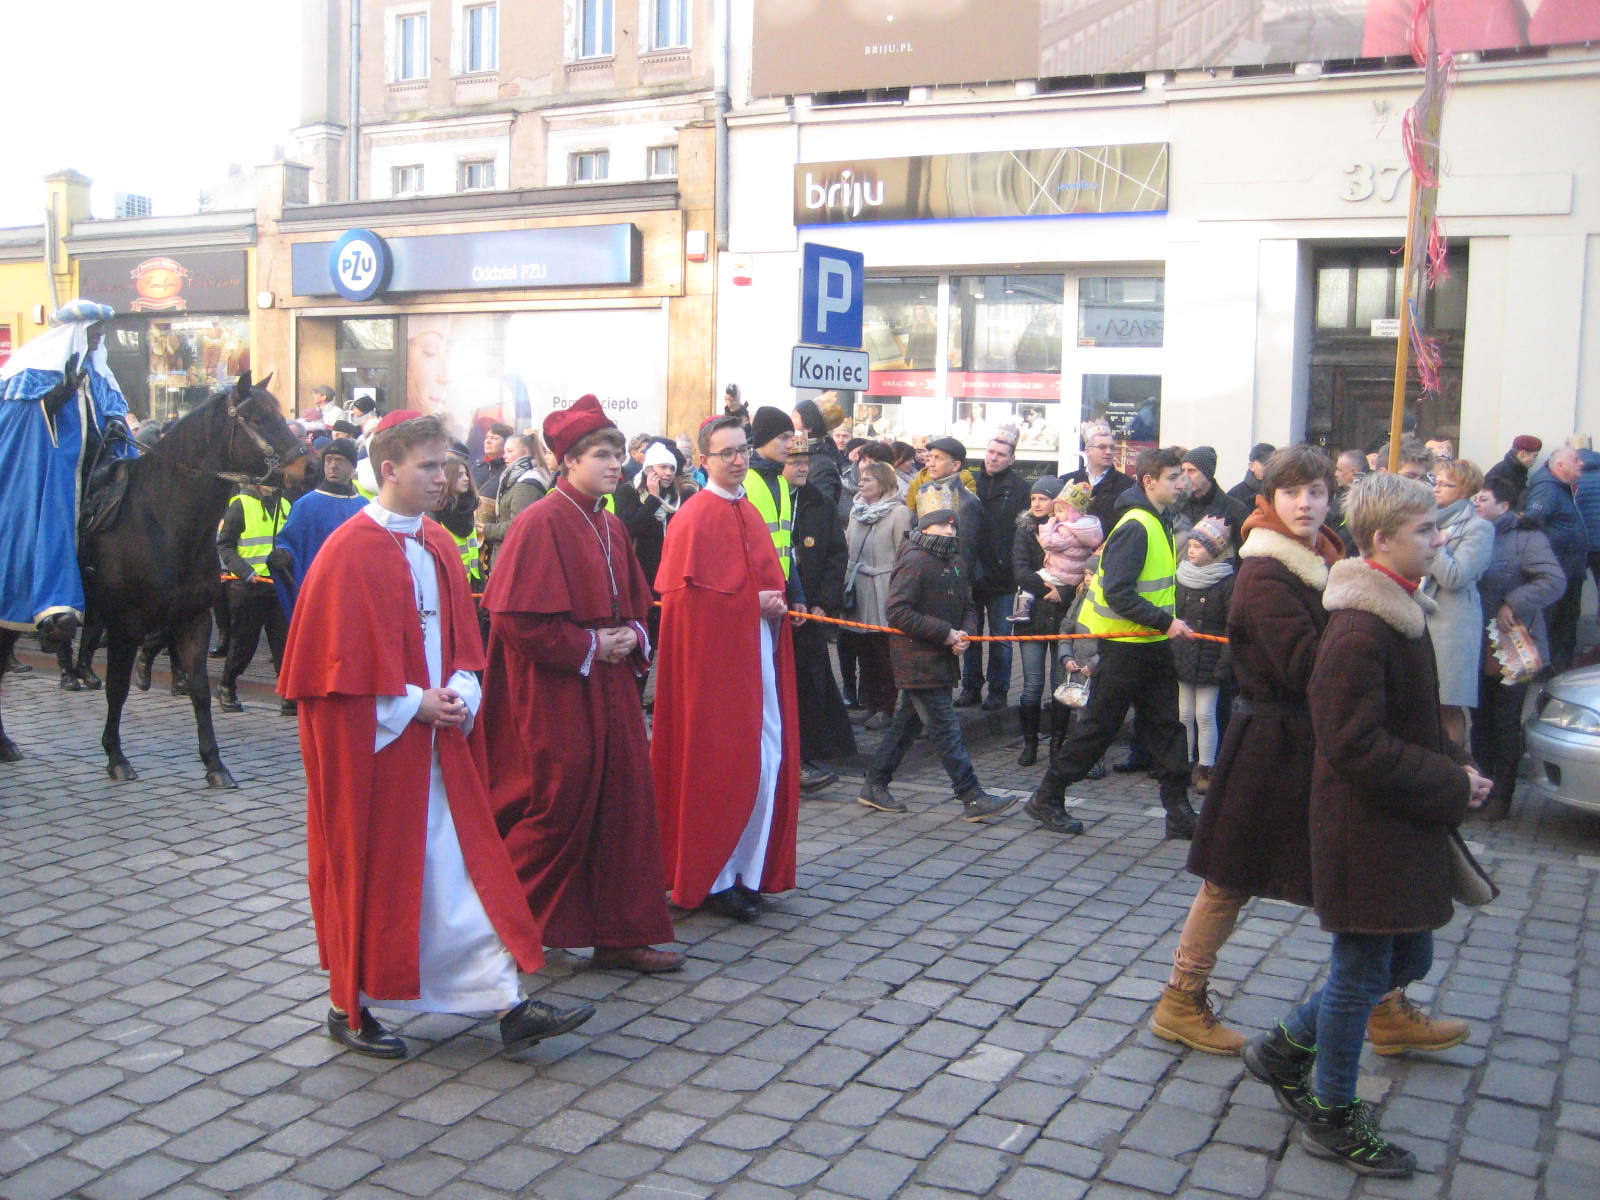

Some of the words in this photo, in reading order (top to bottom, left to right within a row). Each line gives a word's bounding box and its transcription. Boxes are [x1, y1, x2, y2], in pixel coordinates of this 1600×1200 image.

[863, 43, 913, 55] BRIJU.PL
[805, 170, 884, 218] briju
[1339, 160, 1412, 203] 37
[342, 250, 372, 281] PZU
[472, 264, 517, 281] Oddział
[521, 263, 546, 279] PZU
[816, 256, 852, 333] P
[799, 355, 863, 383] Koniec
[601, 397, 639, 412] ciepło
